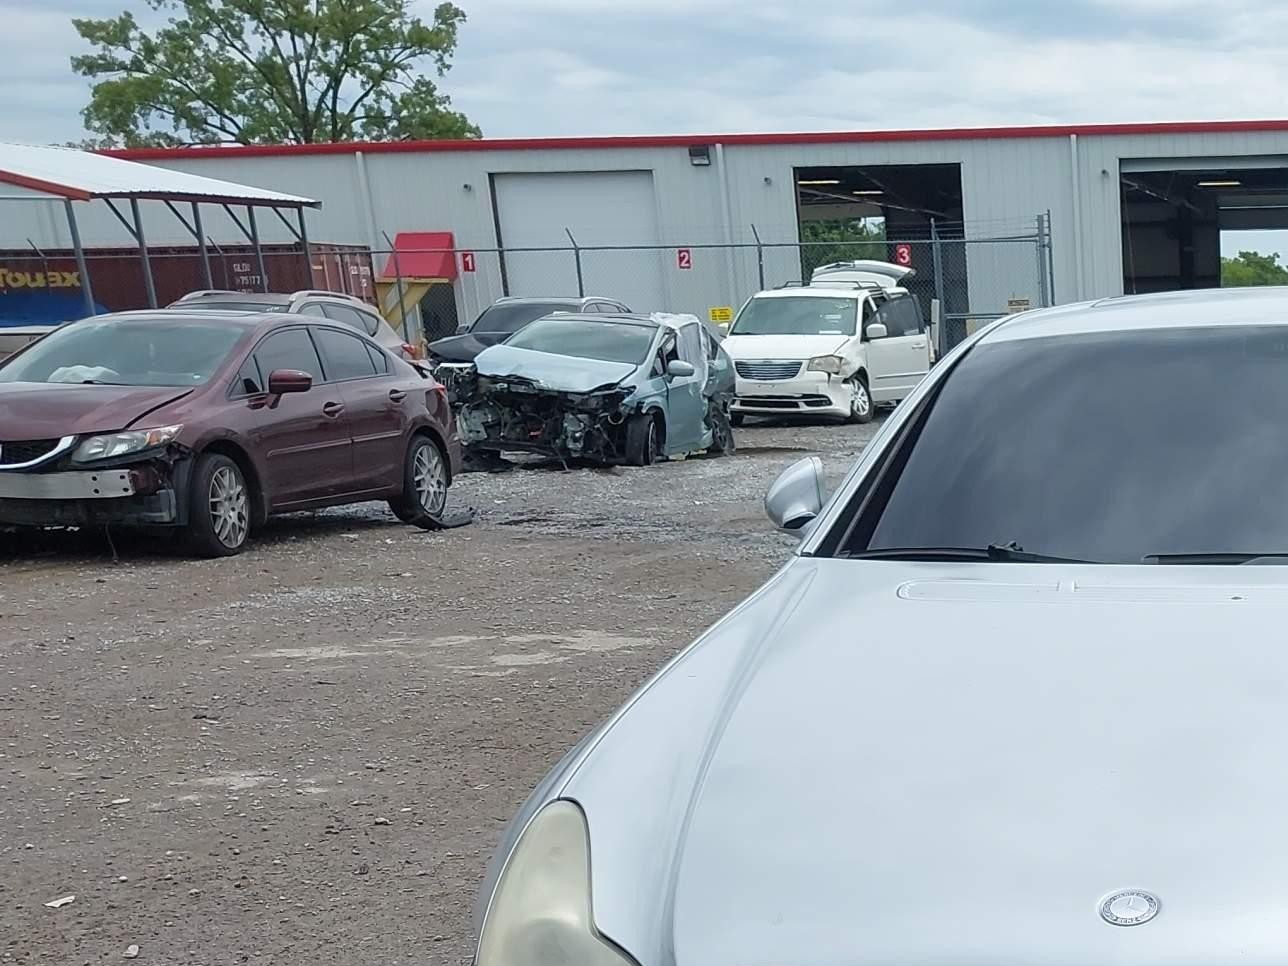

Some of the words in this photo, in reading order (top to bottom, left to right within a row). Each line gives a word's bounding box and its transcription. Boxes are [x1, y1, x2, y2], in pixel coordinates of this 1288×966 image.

[465, 255, 472, 270] 1
[680, 252, 690, 267] 2
[900, 247, 909, 264] 3
